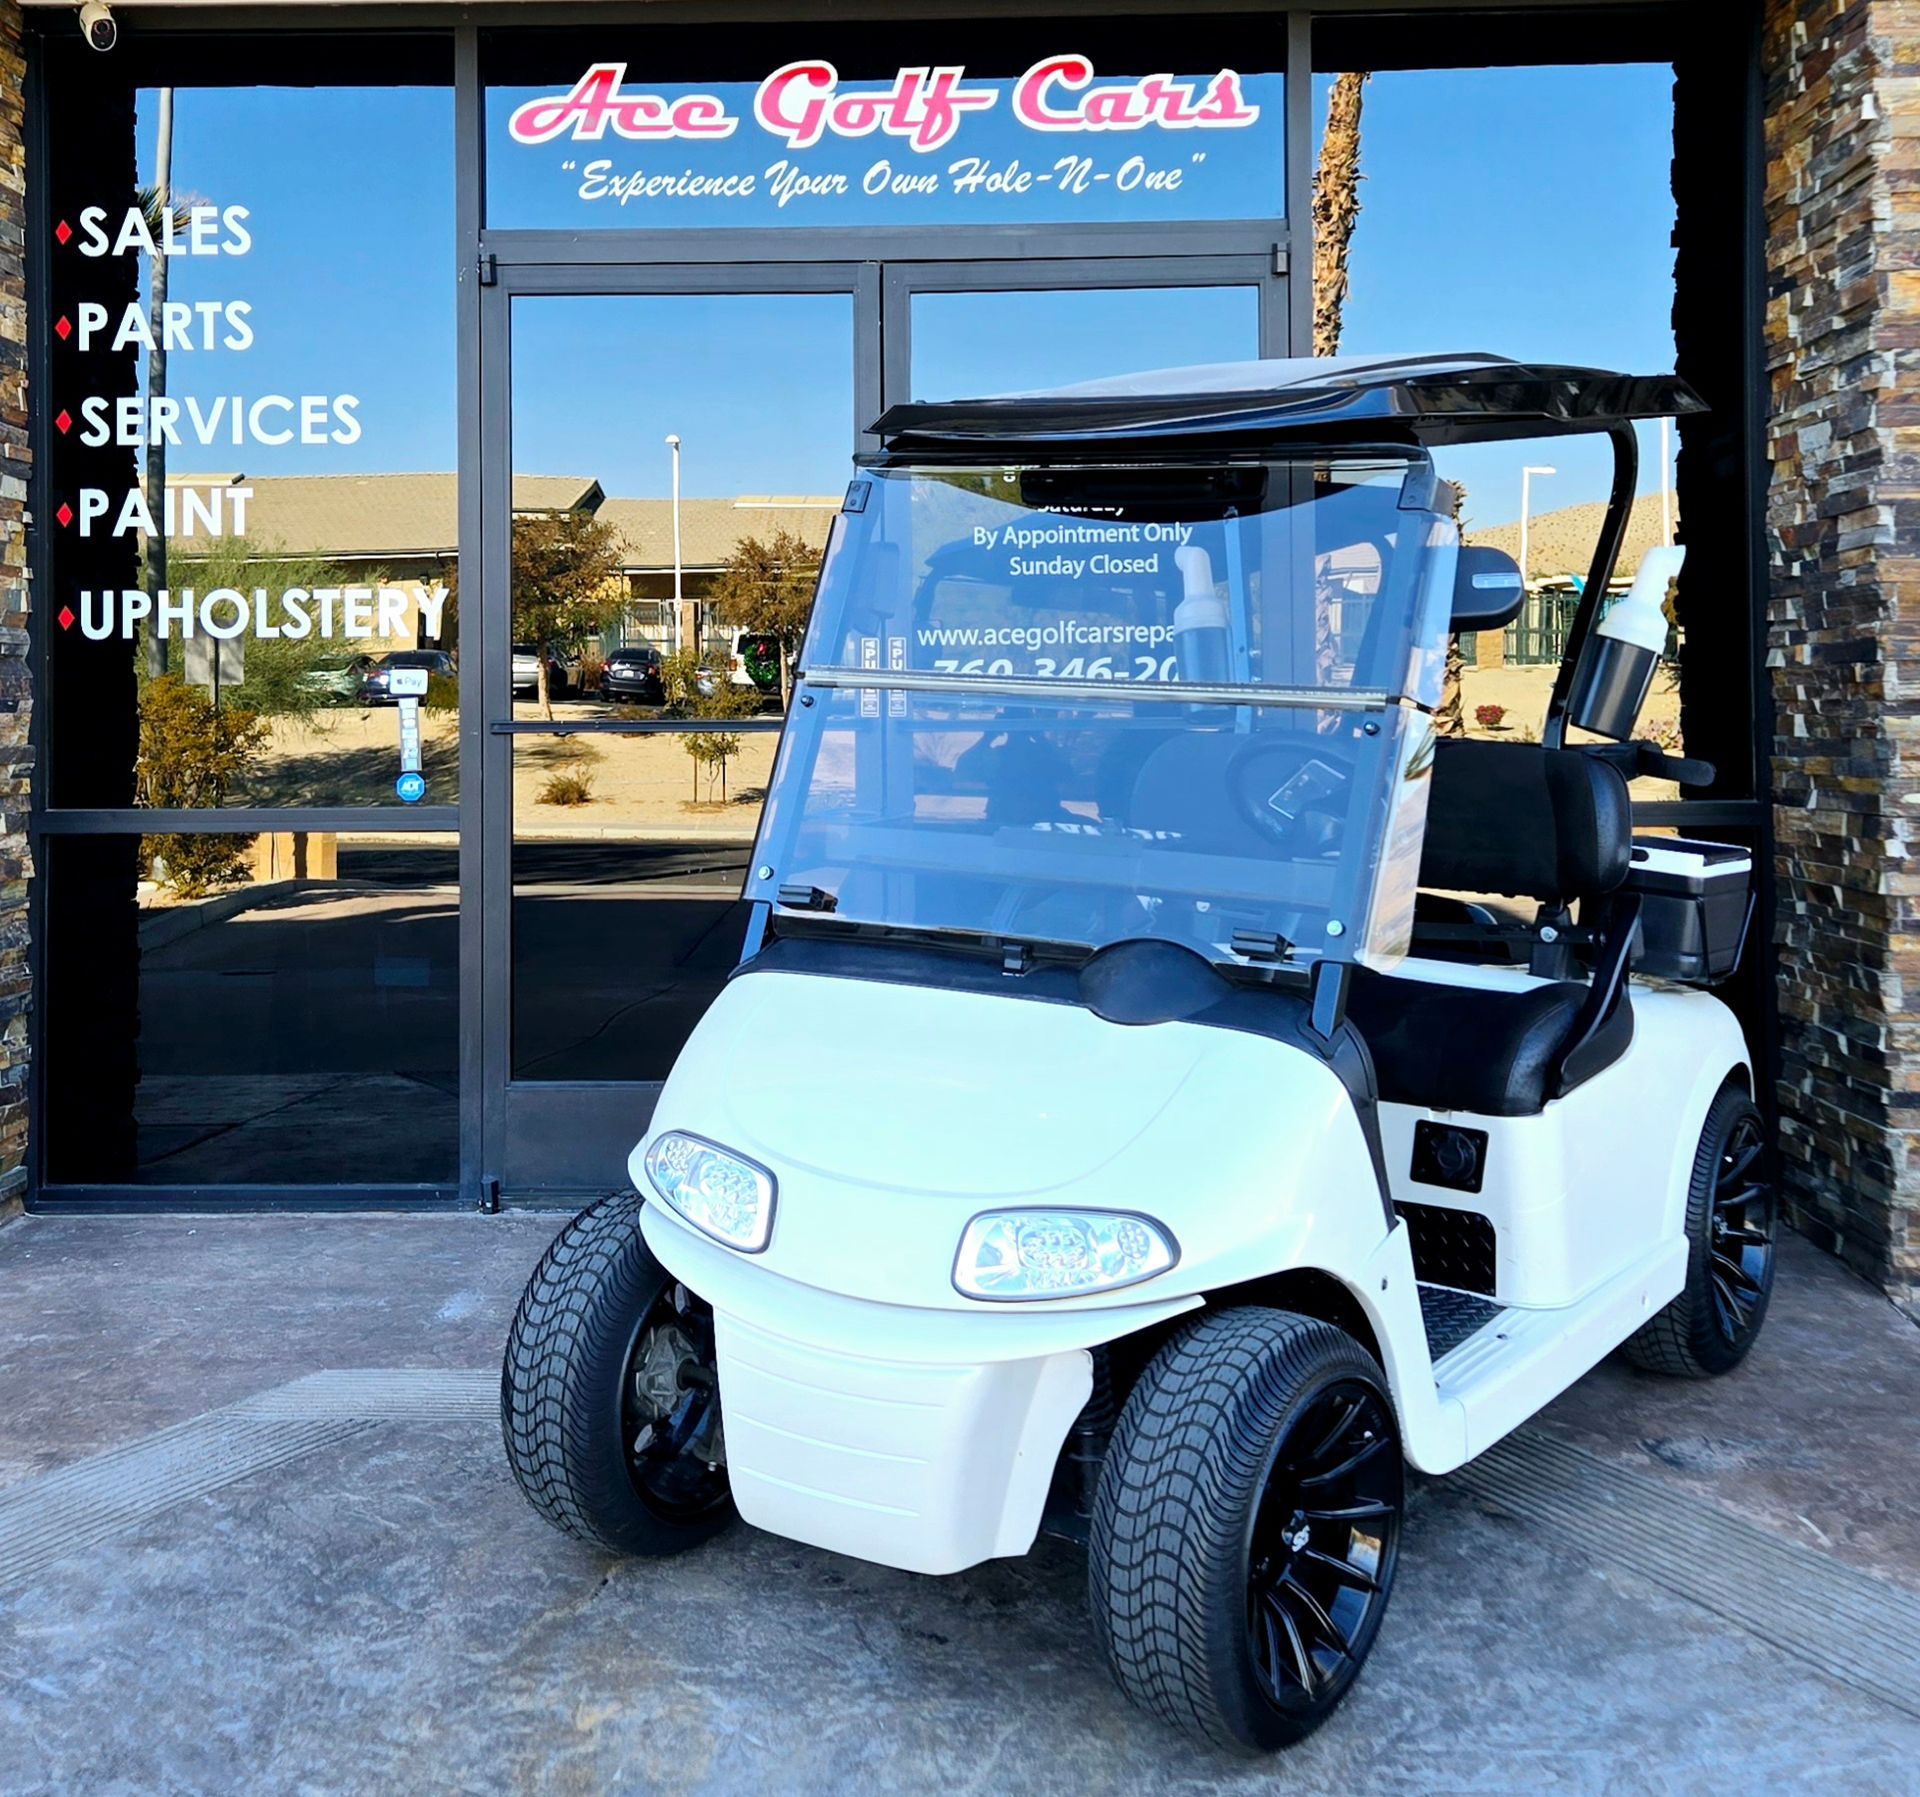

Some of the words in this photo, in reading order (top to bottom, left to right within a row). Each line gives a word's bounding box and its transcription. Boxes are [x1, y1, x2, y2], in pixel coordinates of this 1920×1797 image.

[509, 63, 739, 145] Ace
[754, 60, 998, 153] Golf
[1012, 54, 1260, 132] Cars
[765, 158, 847, 208] Your
[863, 161, 938, 195] Own
[78, 205, 251, 257] SALES
[78, 301, 254, 352] PARTS
[79, 394, 362, 447] SERVICES
[79, 486, 254, 537] PAINT
[973, 526, 998, 550] By
[1002, 525, 1140, 549] Appointment
[1143, 522, 1193, 546] Only
[1009, 555, 1086, 579] Sunday
[1089, 553, 1159, 574] Closed
[80, 587, 450, 640] UPHOLSTERY
[917, 620, 1175, 651] www.acegolfcarsrepa
